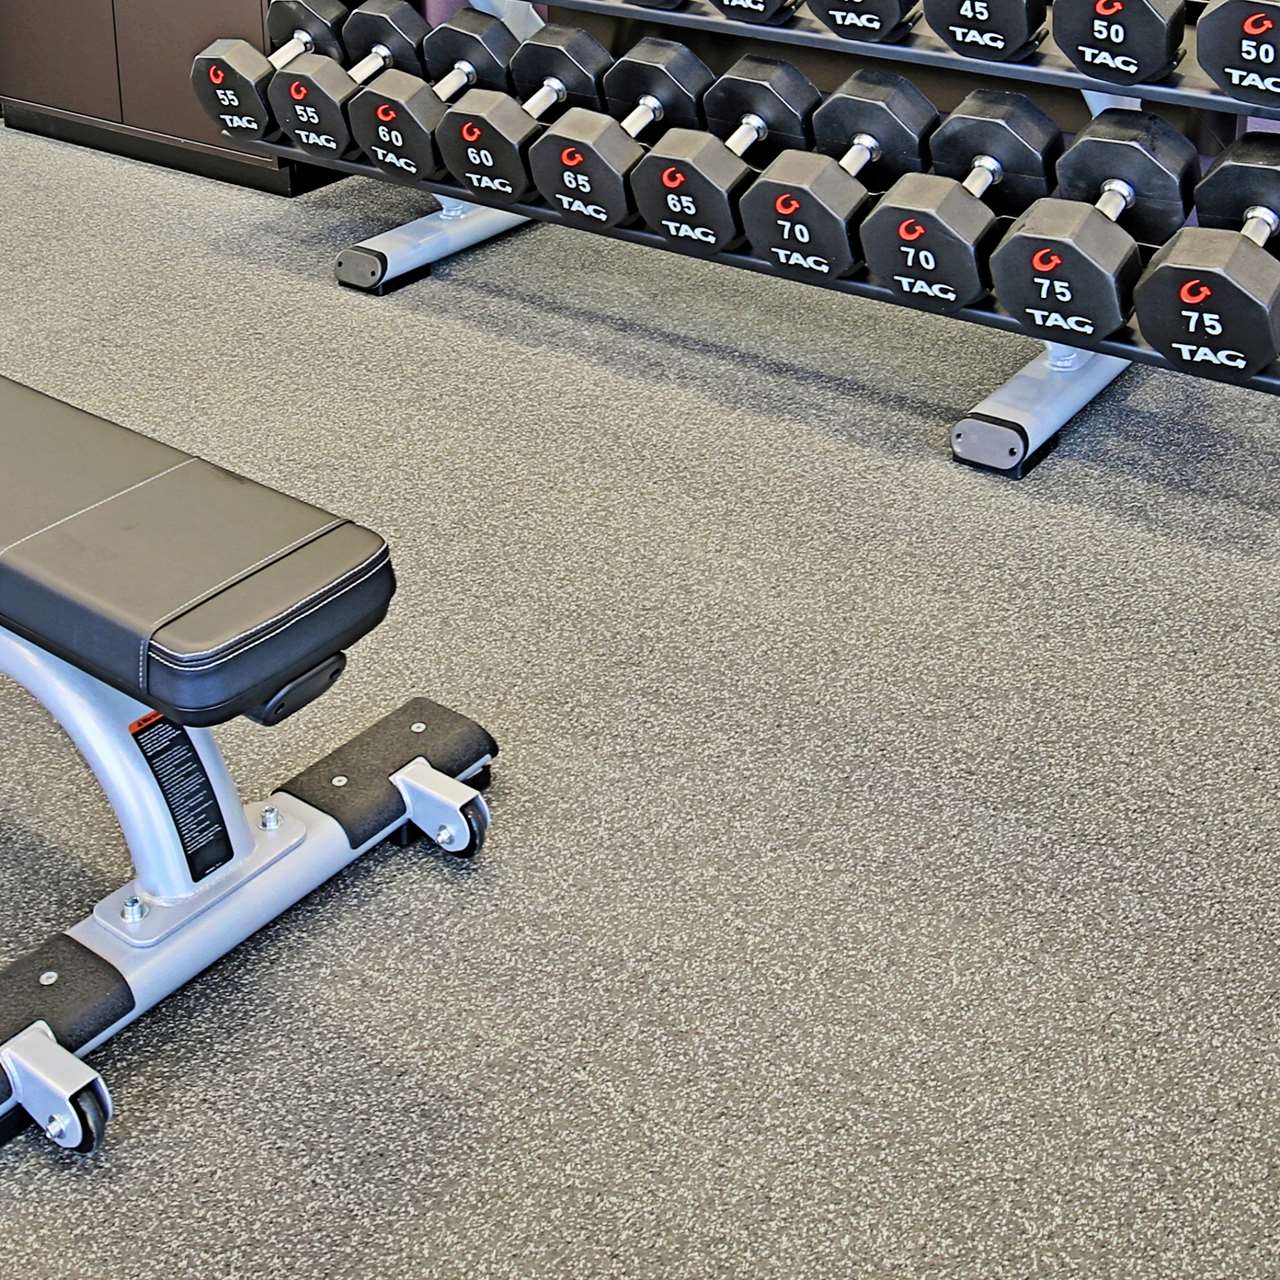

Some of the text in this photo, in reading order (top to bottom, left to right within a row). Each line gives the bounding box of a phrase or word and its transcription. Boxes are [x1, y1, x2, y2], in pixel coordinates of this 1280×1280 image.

[829, 11, 880, 29] TAG
[960, 0, 988, 20] 45
[949, 27, 1004, 48] TAG
[1094, 20, 1123, 42] 50
[1078, 46, 1137, 73] TAG
[1242, 40, 1274, 63] 50
[216, 90, 238, 105] 55
[220, 115, 257, 129] TAG
[295, 105, 318, 123] 55
[295, 130, 336, 149] TAG
[379, 126, 402, 146] 60
[370, 147, 416, 173] TAG
[468, 148, 493, 166] 60
[466, 174, 512, 193] TAG
[564, 172, 590, 192] 65
[556, 194, 607, 221] TAG
[667, 194, 695, 214] 65
[662, 221, 715, 243] TAG
[777, 220, 809, 242] 70
[771, 248, 829, 272] TAG
[901, 247, 934, 269] 70
[894, 276, 956, 300] TAG
[1034, 278, 1071, 301] 75
[1026, 309, 1093, 334] TAG
[1182, 311, 1222, 335] 75
[1172, 343, 1246, 368] TAG
